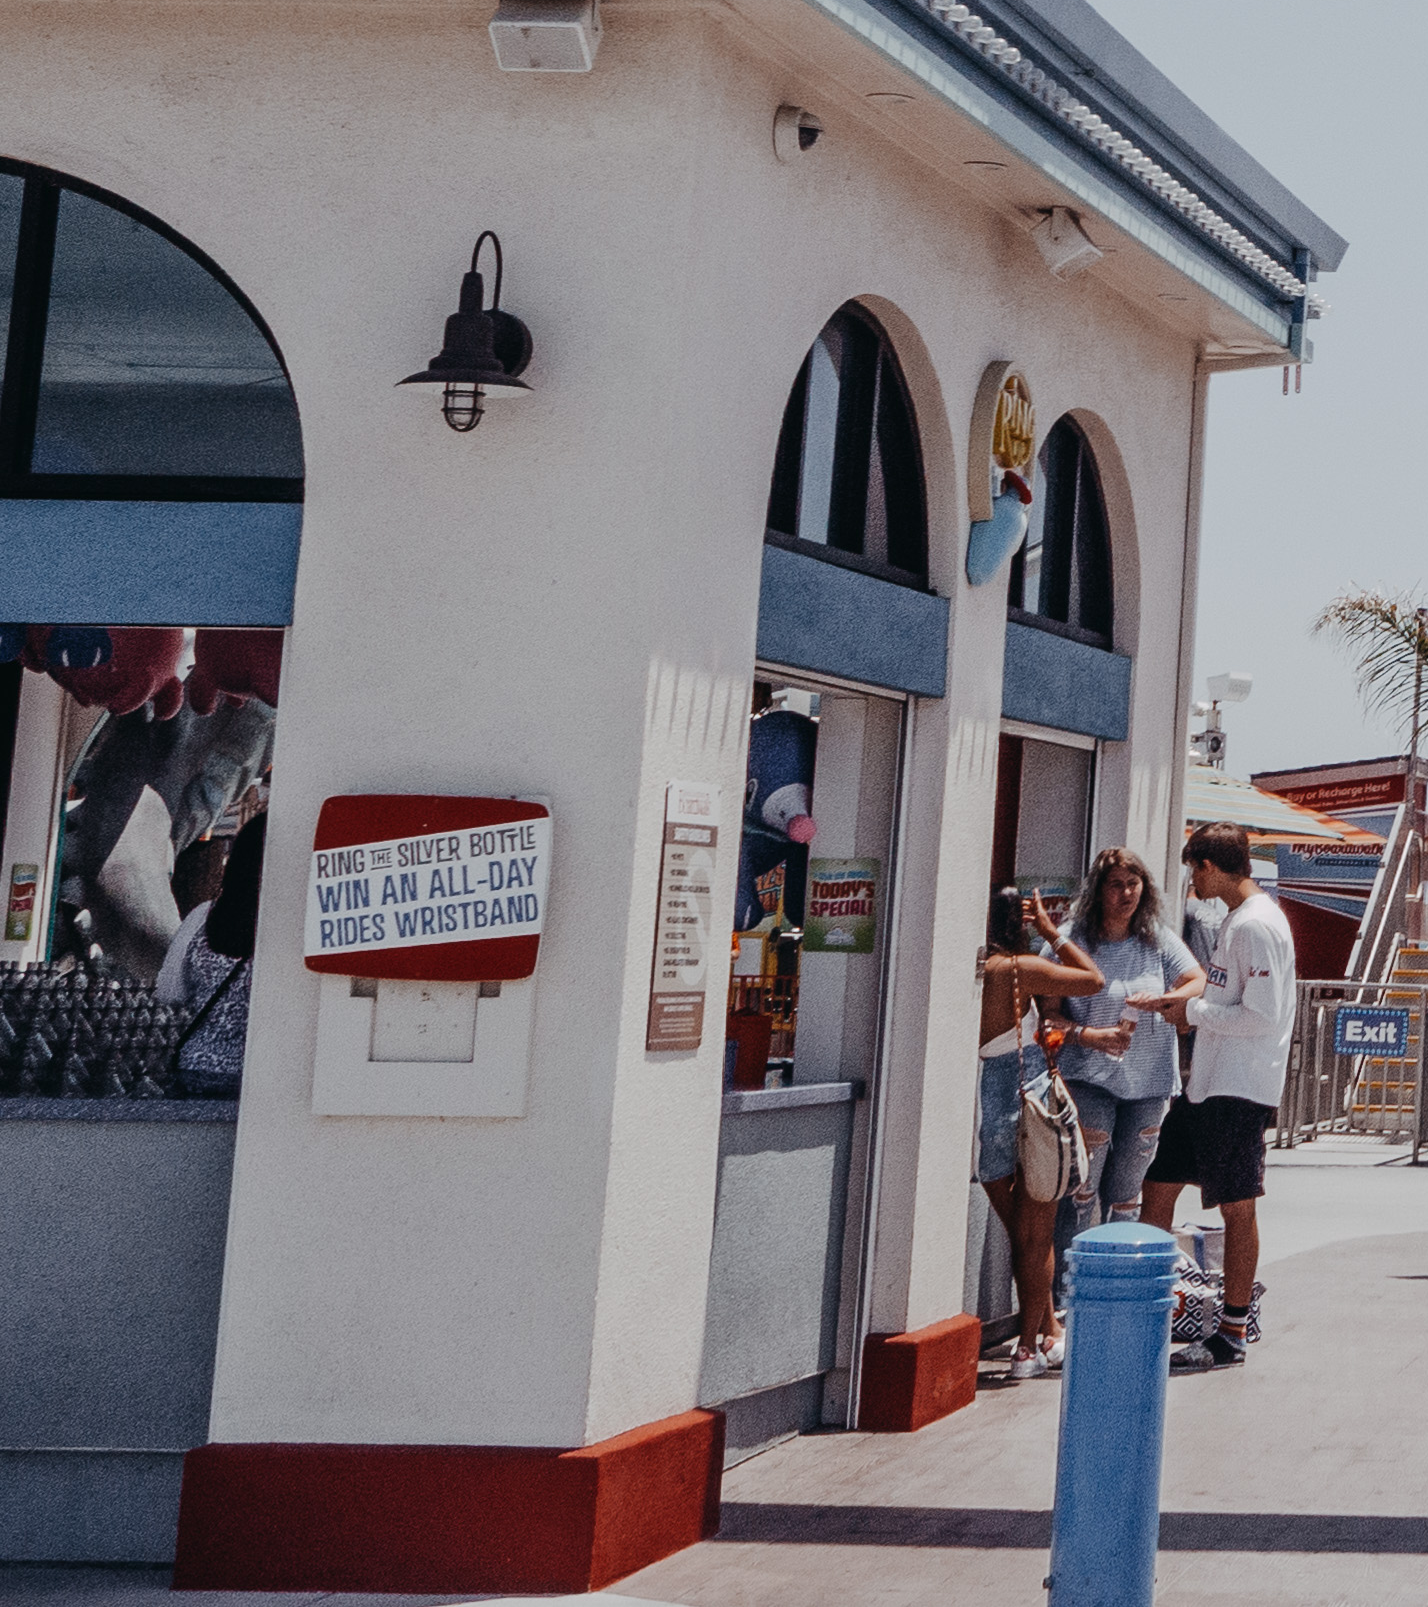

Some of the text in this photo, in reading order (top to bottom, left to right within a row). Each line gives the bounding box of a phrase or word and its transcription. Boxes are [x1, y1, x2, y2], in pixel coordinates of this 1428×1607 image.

[1000, 389, 1036, 453] RING
[1306, 791, 1316, 800] or
[1318, 786, 1364, 798] Recharge
[1364, 781, 1391, 793] Here!
[317, 825, 537, 879] RING THE SILVER BOTTLE
[316, 856, 538, 914] WIN AN ALL-DAY
[811, 881, 876, 900] TODAY'S
[320, 893, 538, 948] RIDES WRISTBAND
[810, 900, 873, 917] SPECIAL!
[1345, 1020, 1398, 1043] Exit
